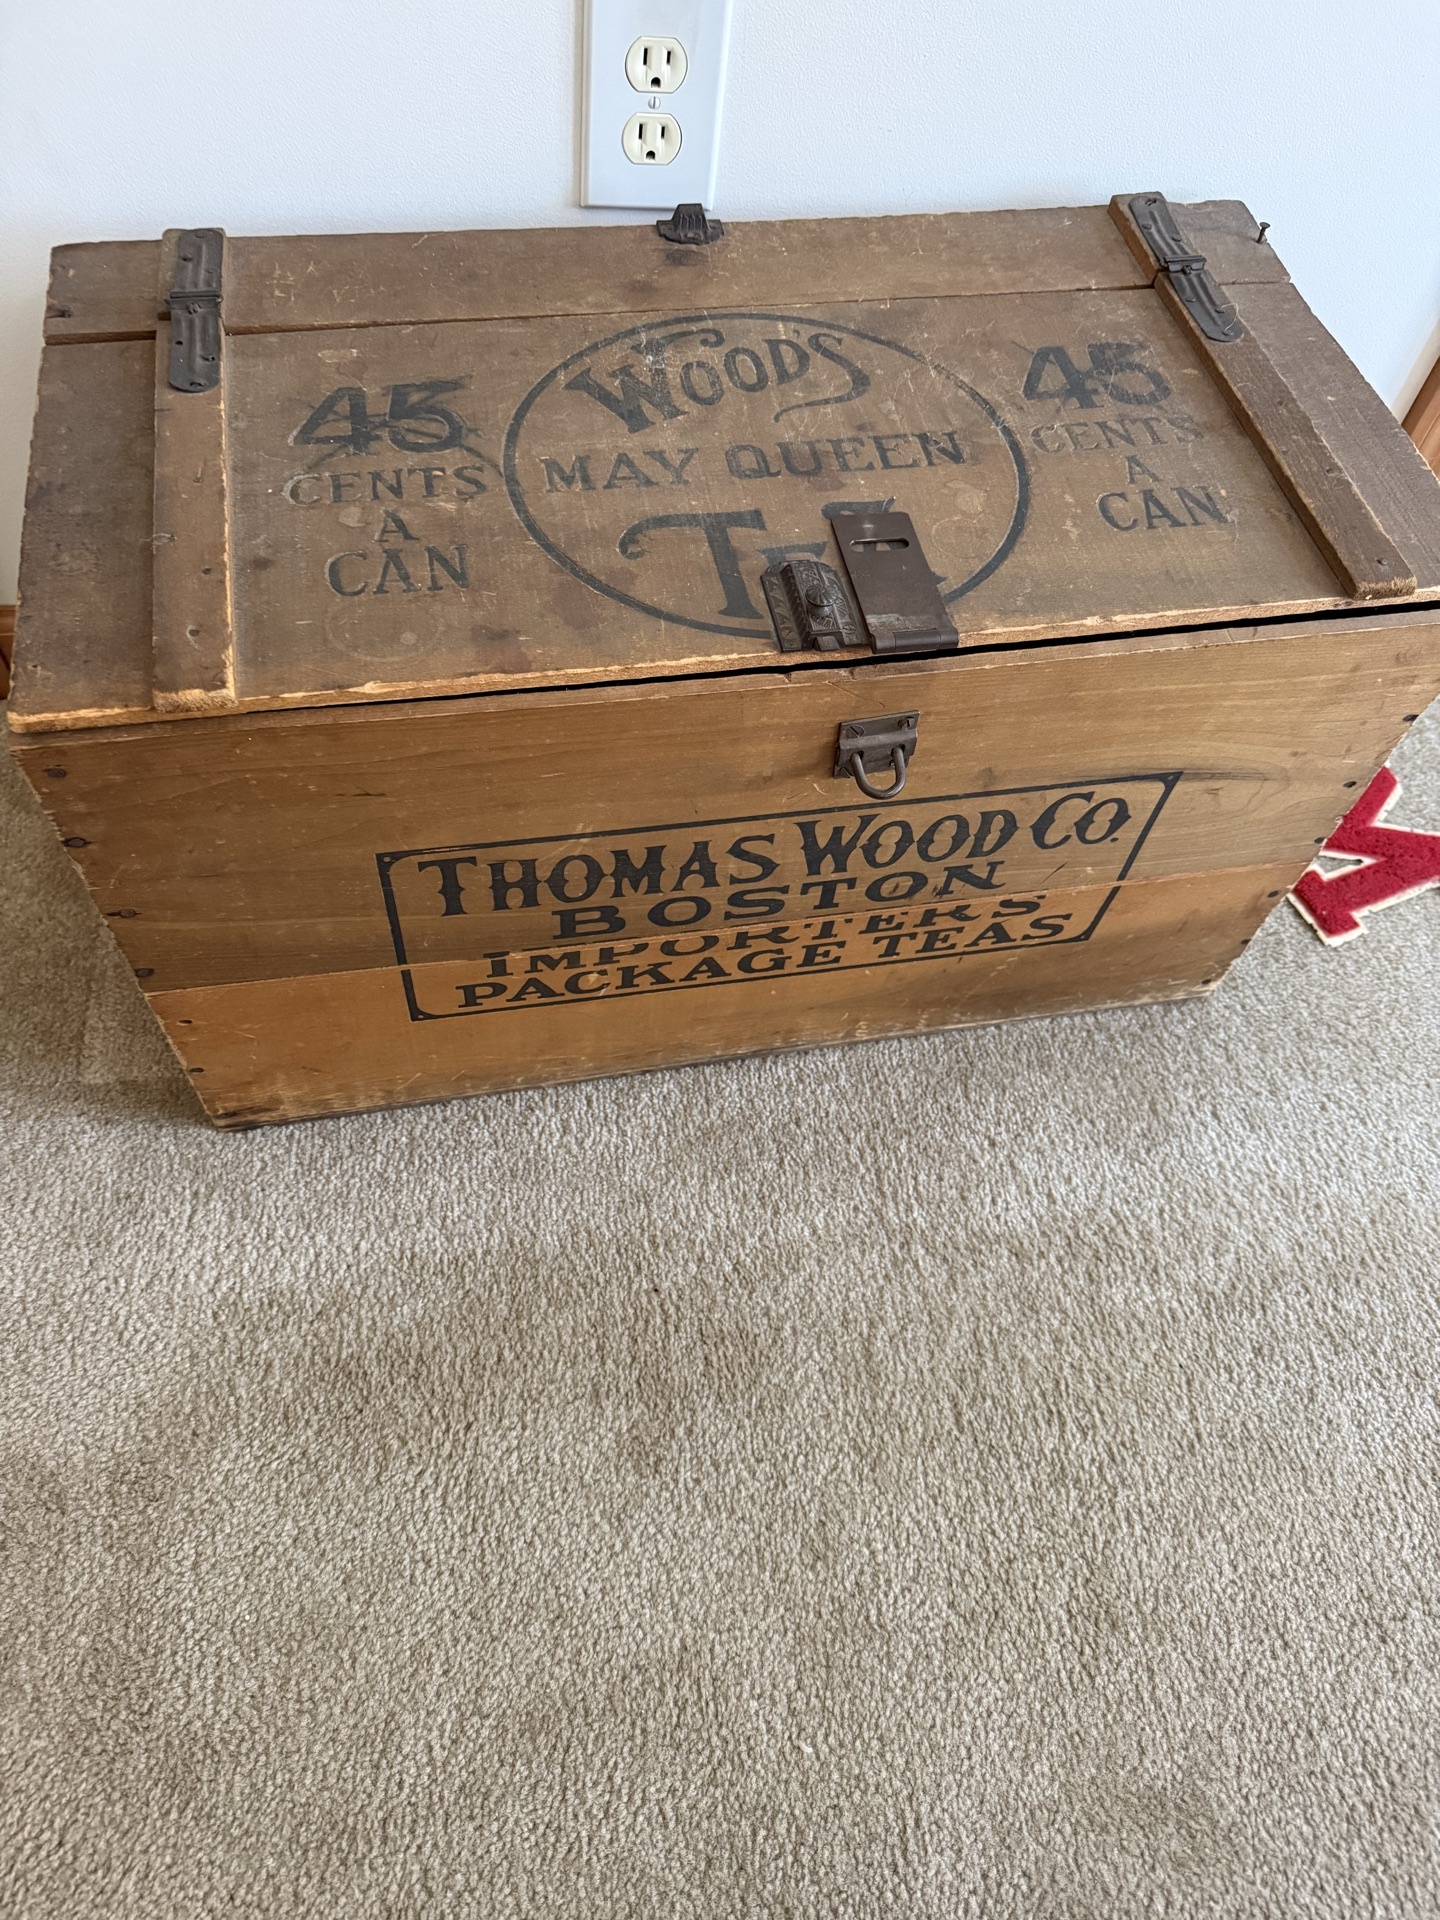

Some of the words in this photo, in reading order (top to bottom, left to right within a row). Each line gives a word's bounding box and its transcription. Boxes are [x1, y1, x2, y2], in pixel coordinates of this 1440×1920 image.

[1022, 341, 1172, 409] 45
[291, 373, 474, 457] 45
[1031, 416, 1204, 453] CENTS
[282, 464, 489, 507] CENTS
[538, 447, 700, 494] MAY
[725, 430, 967, 480] QUEEN
[1124, 454, 1164, 484] A
[373, 509, 420, 543] A
[1096, 484, 1234, 532] CAN
[324, 544, 471, 597] CAN
[418, 833, 780, 917] THOMAS
[795, 809, 1021, 877] WOOD
[551, 860, 1007, 940] BOSTON
[455, 941, 847, 1009] PACKAGE
[873, 912, 1073, 959] TEAS
[483, 893, 1047, 978] IMPORTERS
